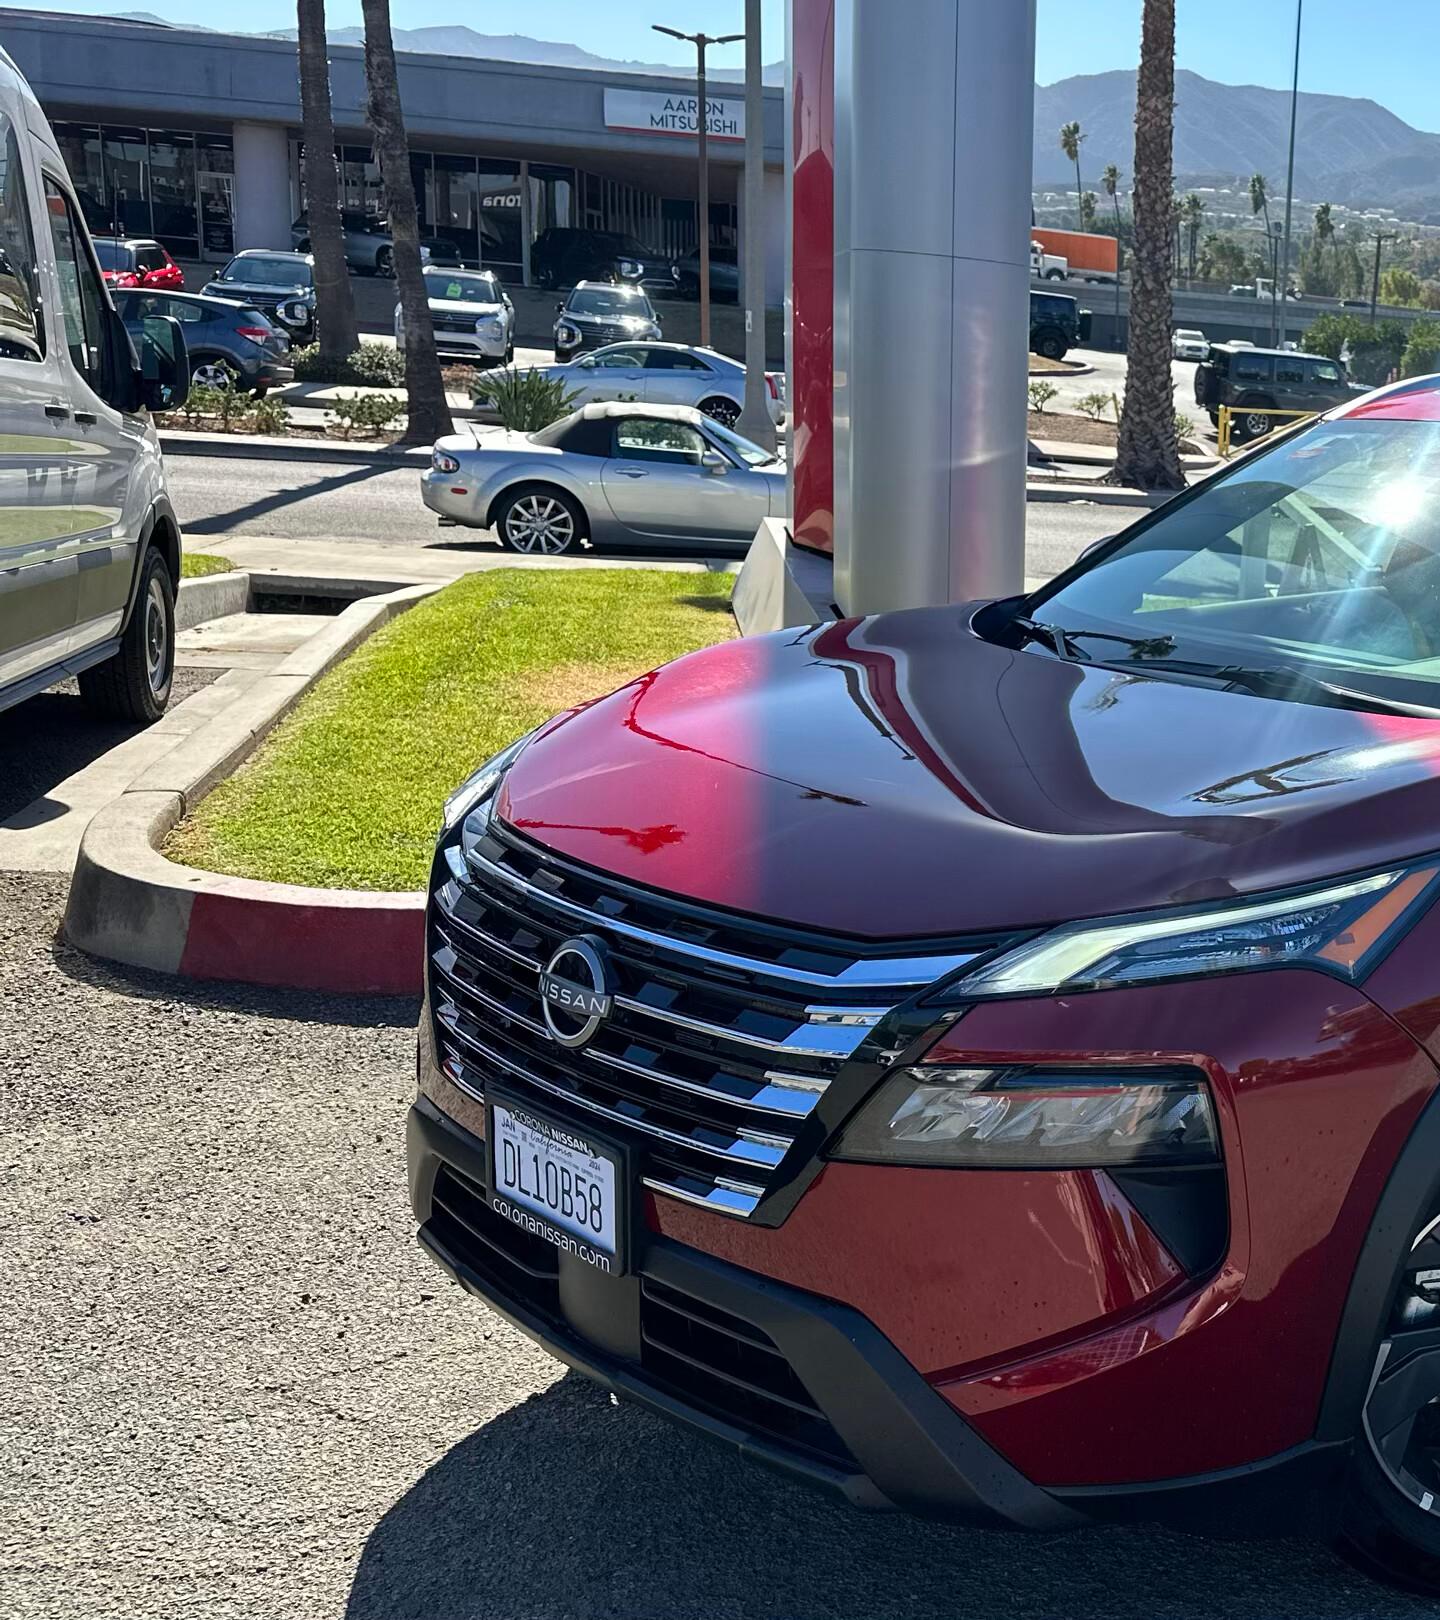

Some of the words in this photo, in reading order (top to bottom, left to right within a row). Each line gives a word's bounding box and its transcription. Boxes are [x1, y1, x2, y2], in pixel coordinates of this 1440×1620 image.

[540, 973, 606, 1013] NISSAN
[501, 1118, 516, 1132] JAN
[514, 1110, 551, 1137] CORONA
[551, 1128, 589, 1153] NISSAN
[530, 1129, 573, 1158] California
[503, 1138, 603, 1233] DL10B58
[493, 1198, 610, 1273] coronanissan.com
